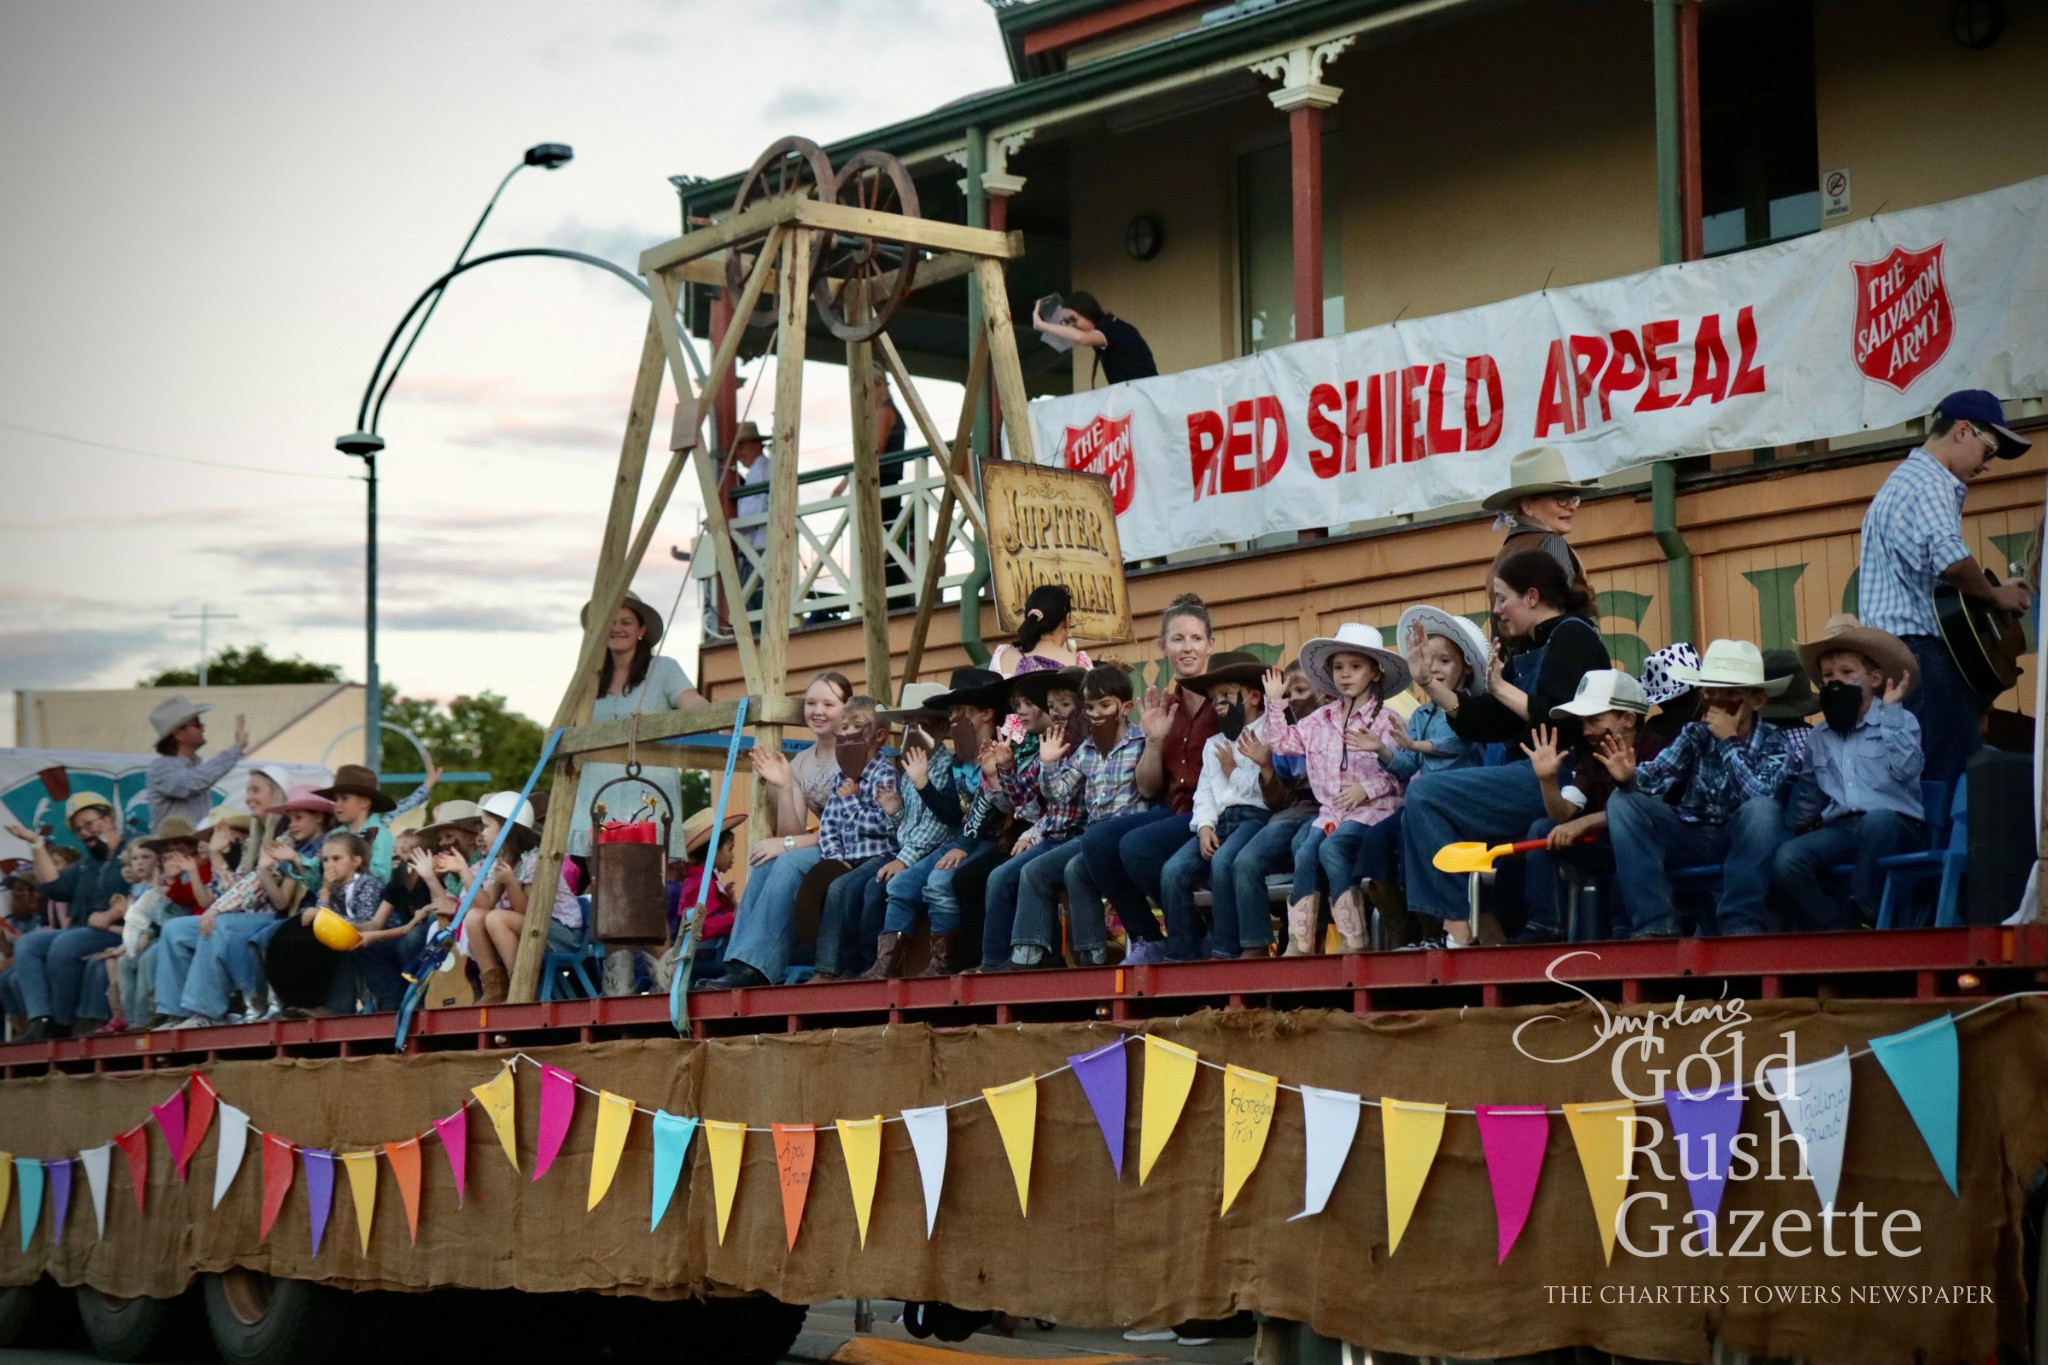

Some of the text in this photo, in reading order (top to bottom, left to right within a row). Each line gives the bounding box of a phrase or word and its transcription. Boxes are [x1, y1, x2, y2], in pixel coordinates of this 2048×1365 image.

[1858, 255, 1940, 363] SALVATION
[1868, 257, 1906, 311] THE
[1887, 299, 1940, 379] ARMY
[1186, 305, 1766, 502] RED SHIELD APPEAL
[1072, 422, 1104, 466] THE
[1001, 485, 1109, 557] JUPITER
